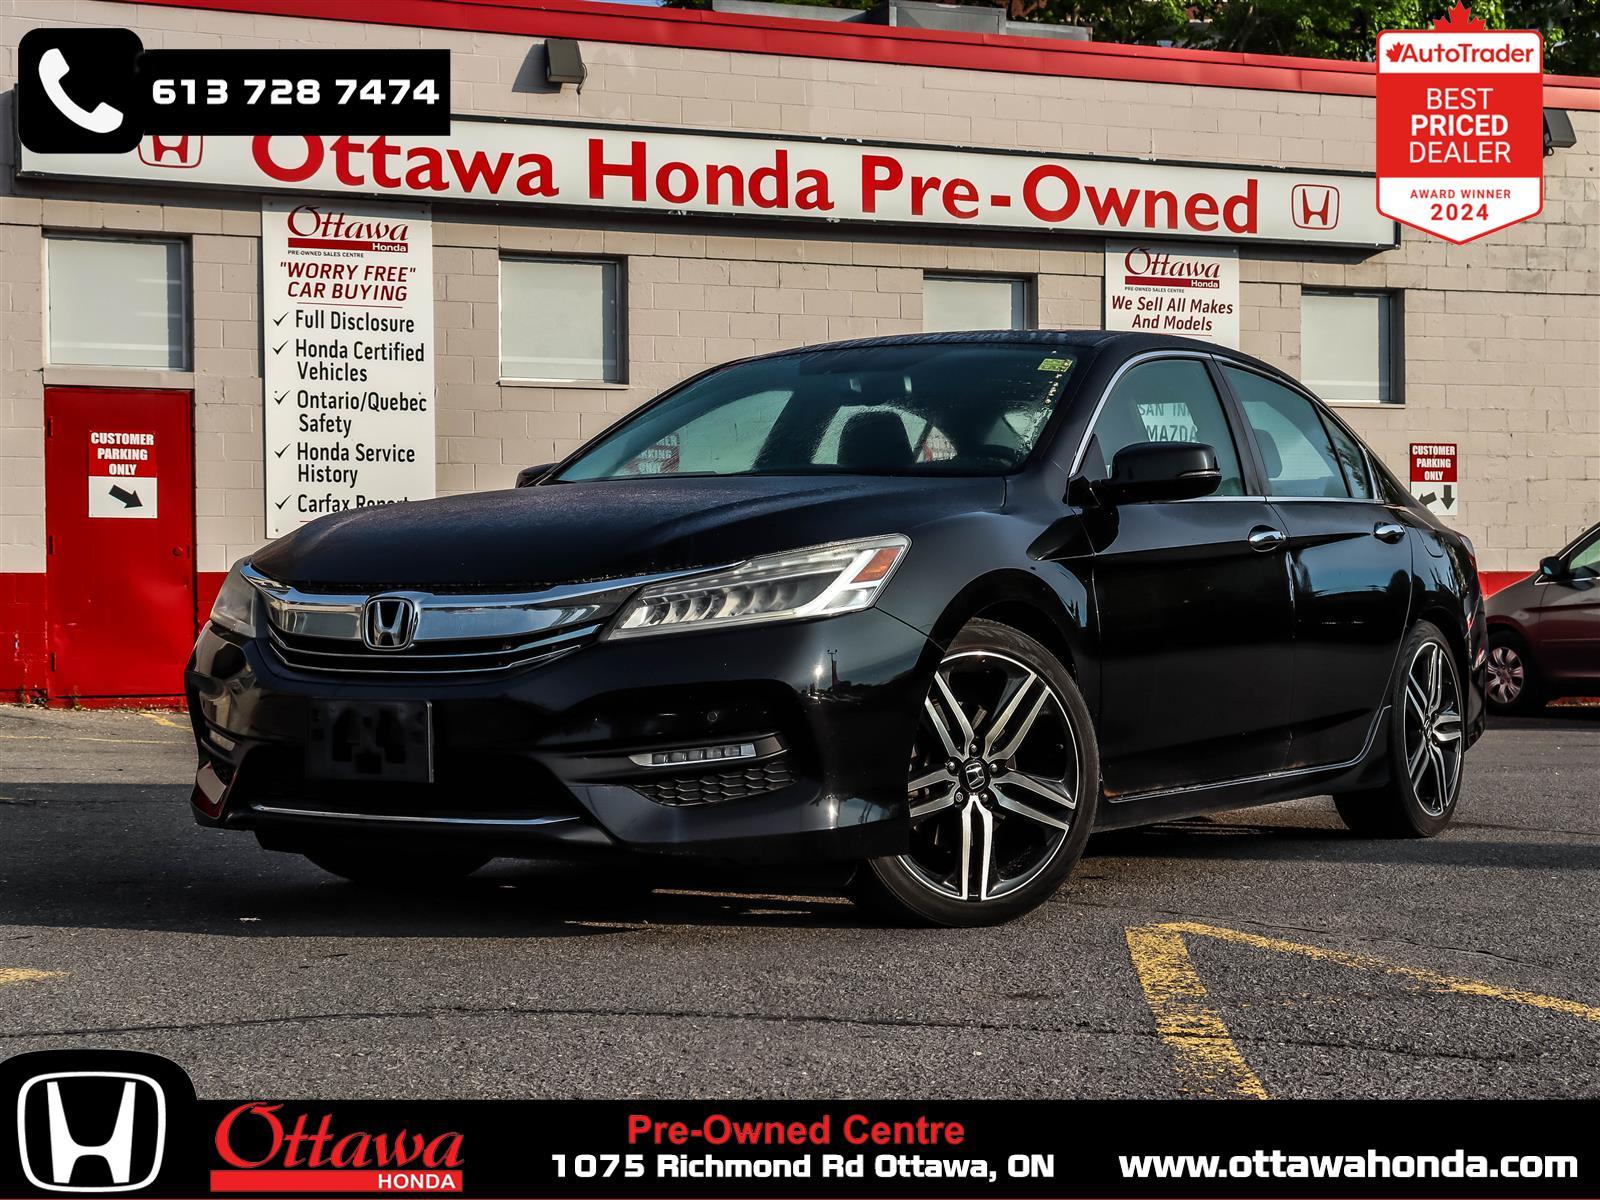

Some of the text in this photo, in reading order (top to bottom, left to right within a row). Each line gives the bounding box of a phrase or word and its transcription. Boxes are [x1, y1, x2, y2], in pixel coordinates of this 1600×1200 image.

[252, 135, 1258, 234] Ottawa Honda Pre-Owned
[287, 204, 409, 241] Ottawa
[372, 242, 407, 252] Honda
[280, 262, 416, 282] "WORRY FREE"
[1124, 246, 1220, 279] Ottawa
[287, 282, 408, 301] CAR BUYING
[1191, 279, 1219, 288] Honda
[1112, 295, 1233, 315] We Sell All Makes
[295, 310, 415, 333] Full Disclosure
[1131, 314, 1213, 331] And Models
[295, 338, 425, 362] Honda Certified
[297, 361, 368, 382] Vehicles
[297, 390, 427, 412] Ontario/Quebec
[1172, 403, 1190, 416] IN
[299, 413, 352, 438] Safety
[1146, 424, 1198, 441] MAZDA
[91, 432, 154, 445] CUSTOMER
[97, 448, 148, 460] PARKING
[297, 442, 415, 462] Honda Service
[1412, 445, 1455, 455] CUSTOMER
[109, 464, 137, 475] ONLY
[1416, 458, 1451, 468] PARKING
[298, 464, 358, 488] History
[1424, 471, 1443, 480] ONLY
[297, 493, 350, 513] Carfax
